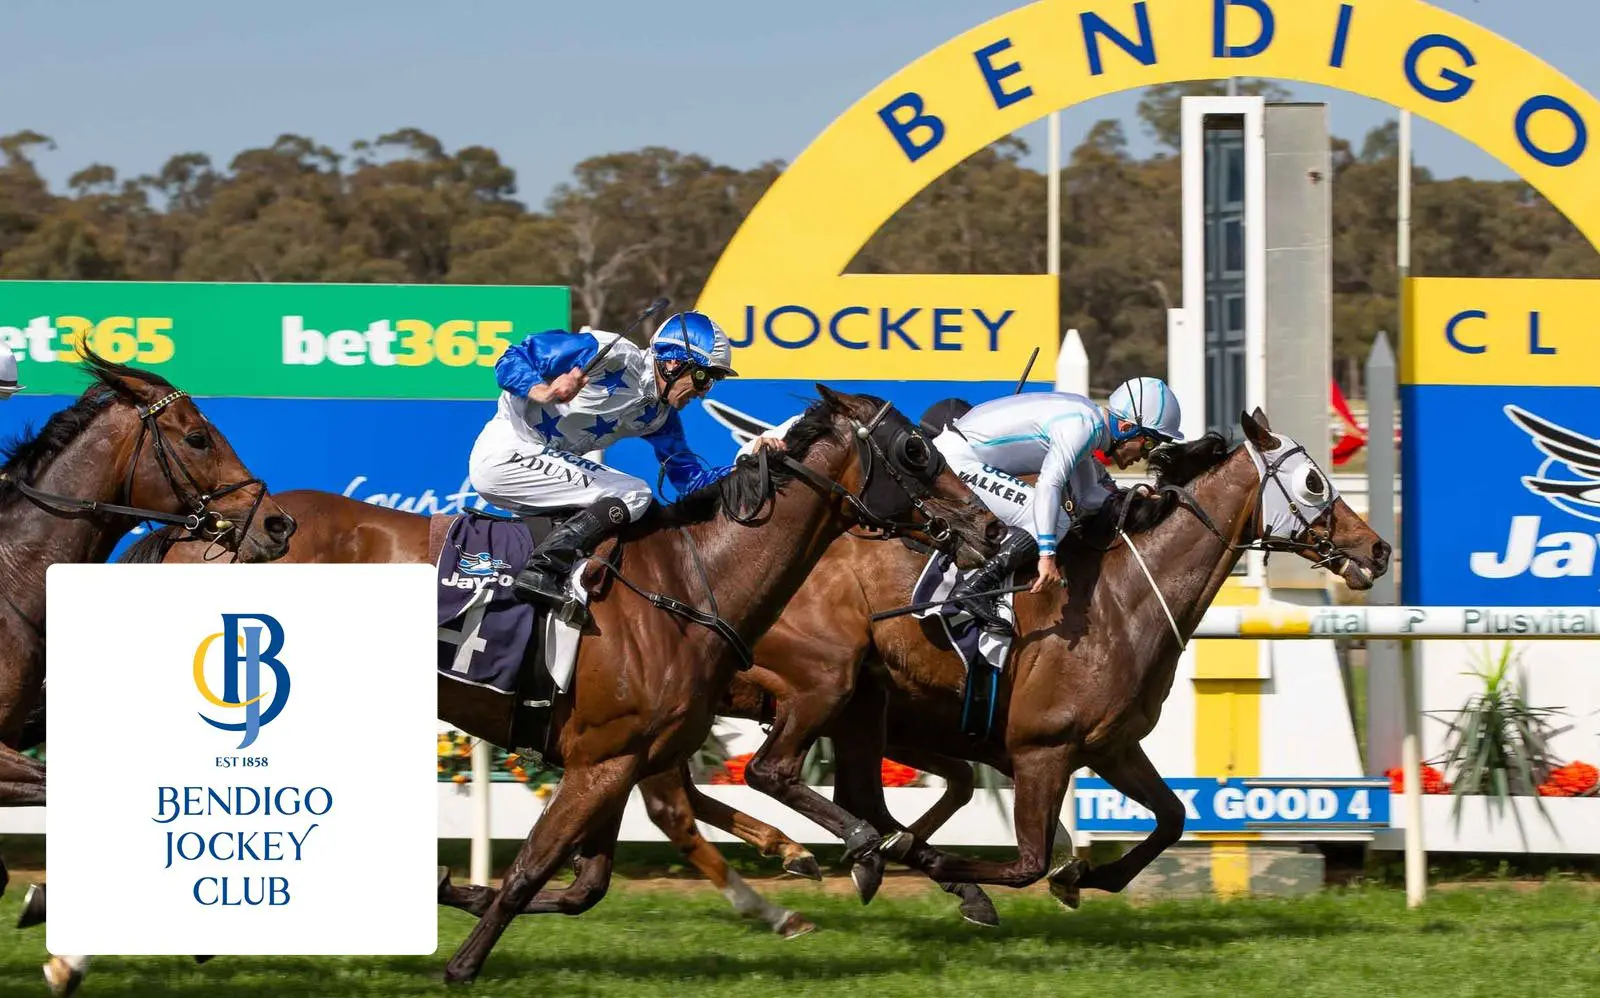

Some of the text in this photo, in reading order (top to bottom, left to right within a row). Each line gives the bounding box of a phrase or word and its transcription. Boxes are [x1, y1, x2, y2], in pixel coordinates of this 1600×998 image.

[878, 0, 1588, 167] BENDIGO
[281, 315, 513, 367] bet365
[729, 305, 1016, 352] JOCKEY
[1469, 515, 1600, 579] Ja
[437, 587, 494, 674] 4
[1463, 608, 1597, 635] Plusvital
[1074, 787, 1372, 820] TRAK GOOD 4
